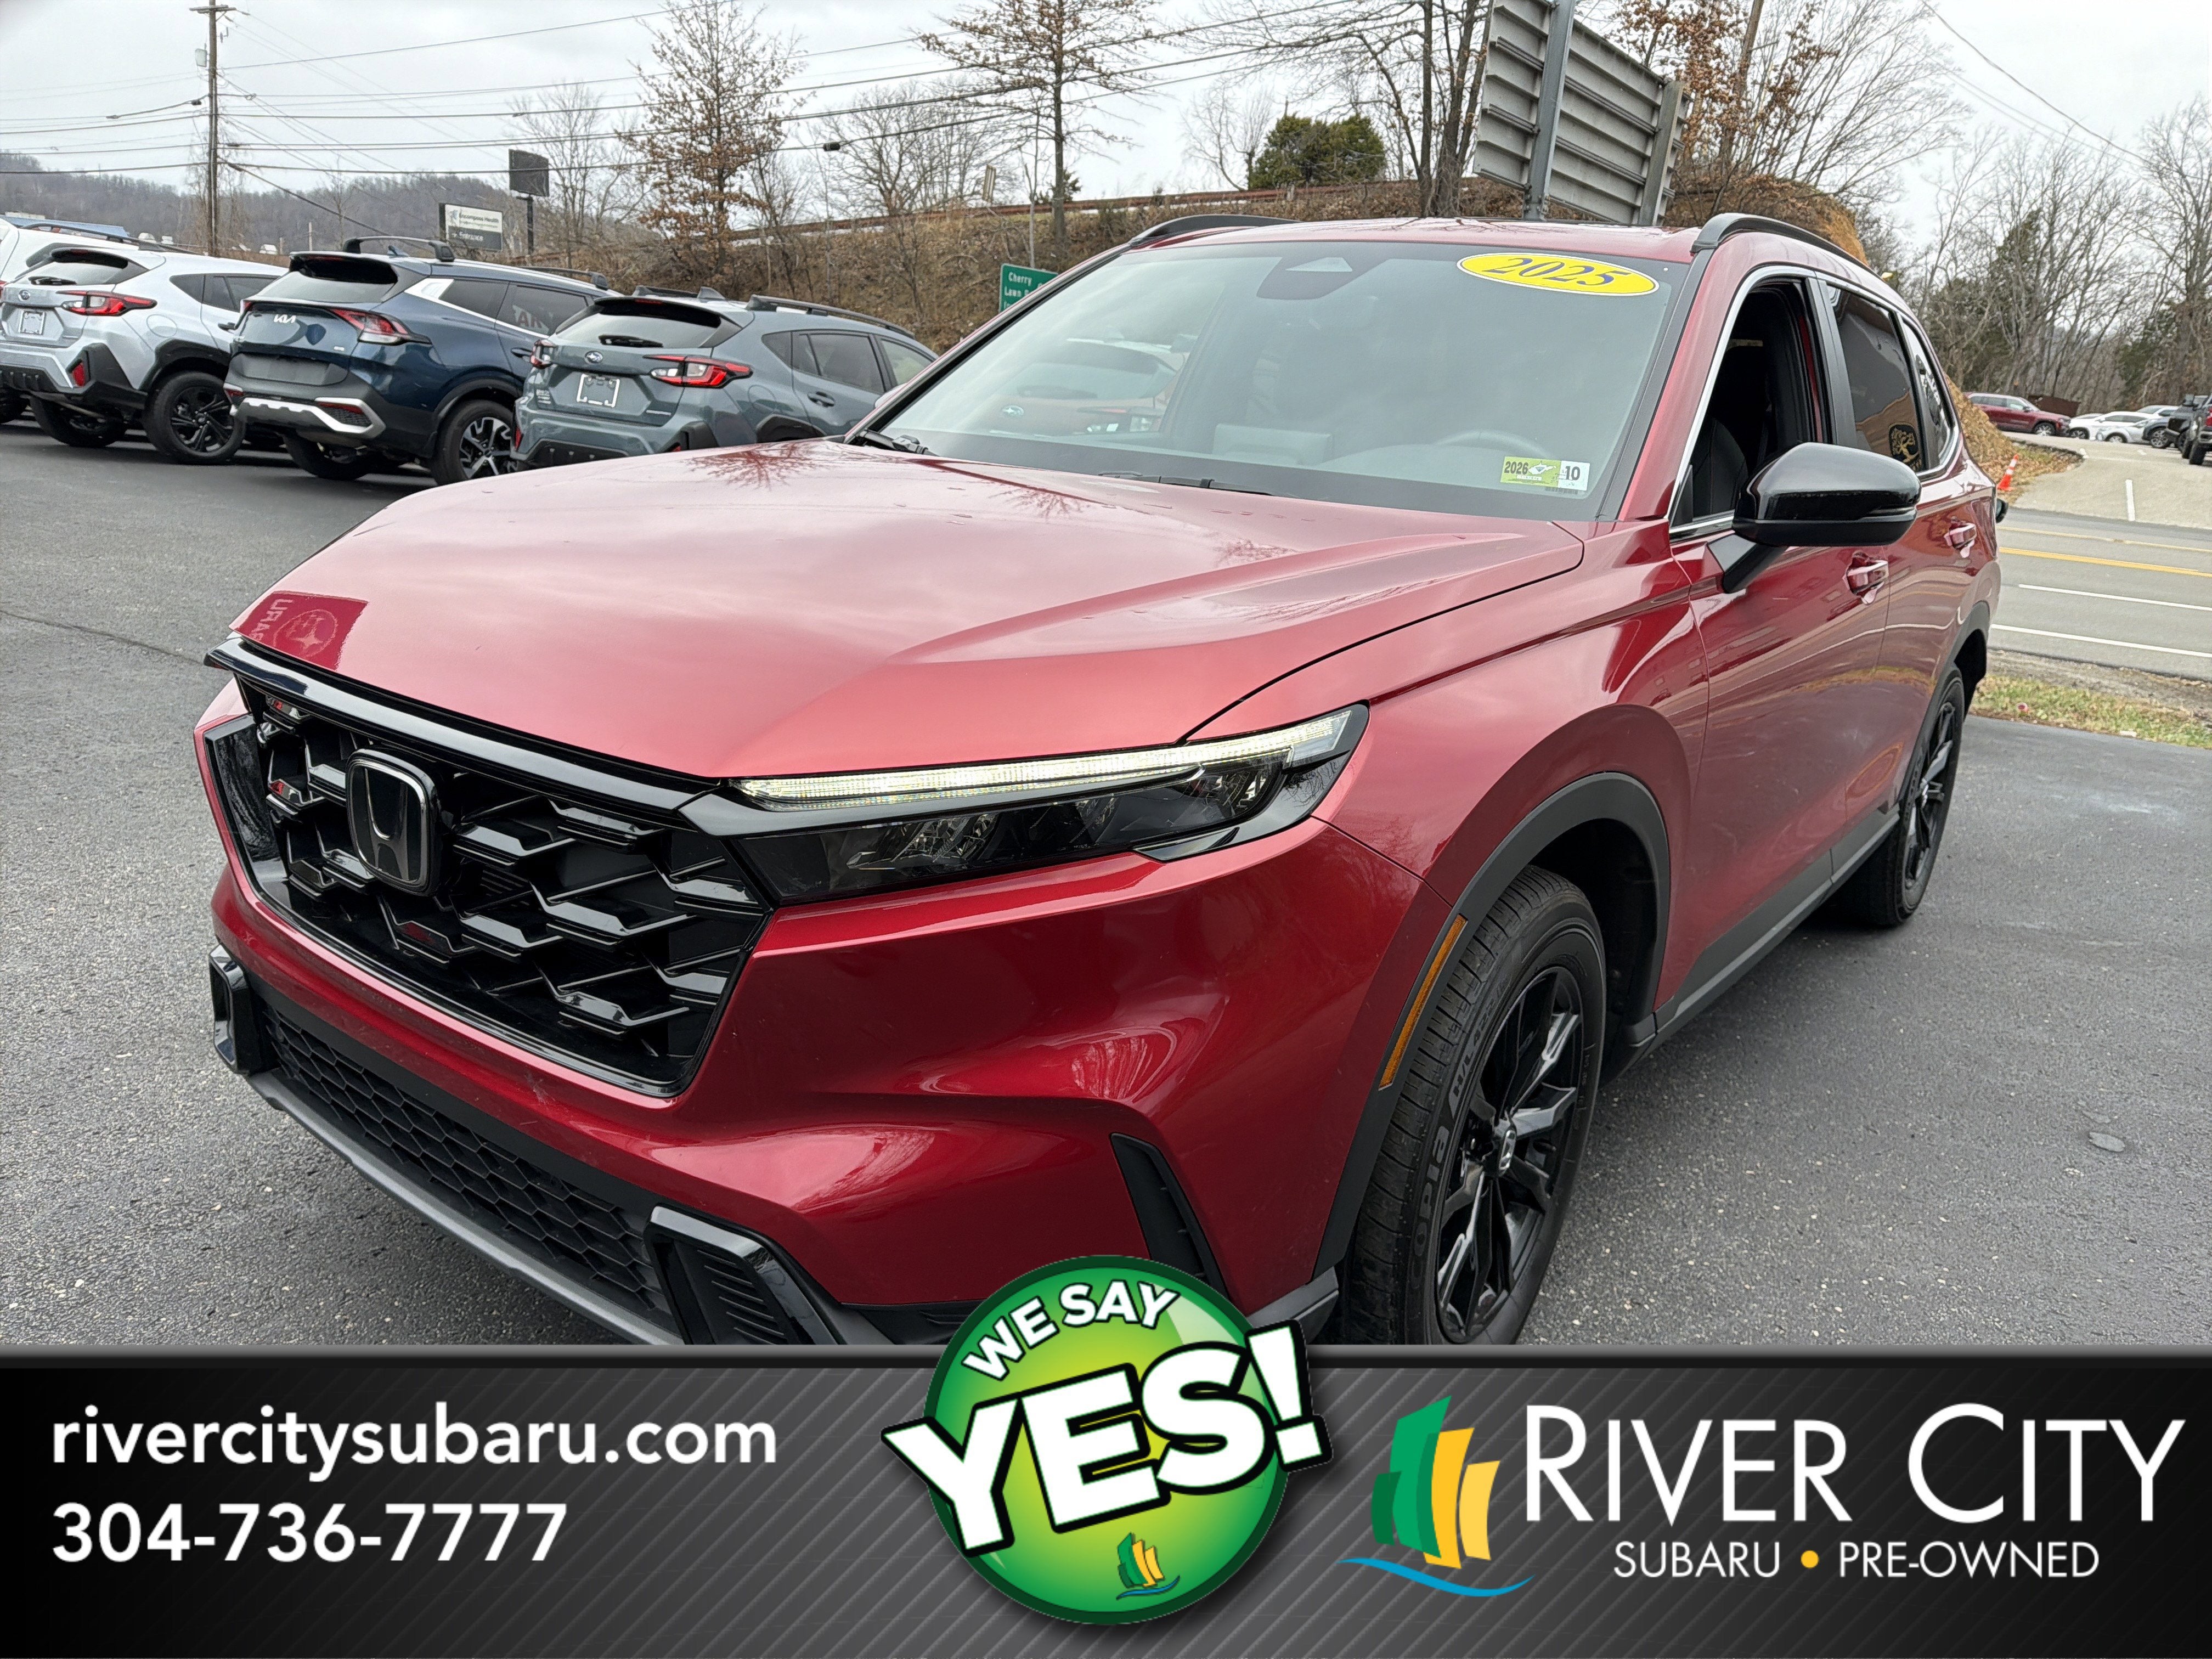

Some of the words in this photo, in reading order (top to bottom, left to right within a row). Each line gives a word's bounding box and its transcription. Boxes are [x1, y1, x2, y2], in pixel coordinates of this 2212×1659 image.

[1008, 271, 1032, 286] Cherry
[1482, 257, 1632, 286] 2025
[1004, 285, 1022, 297] Lawn
[1504, 461, 1529, 475] 2026
[1565, 466, 1581, 481] 10
